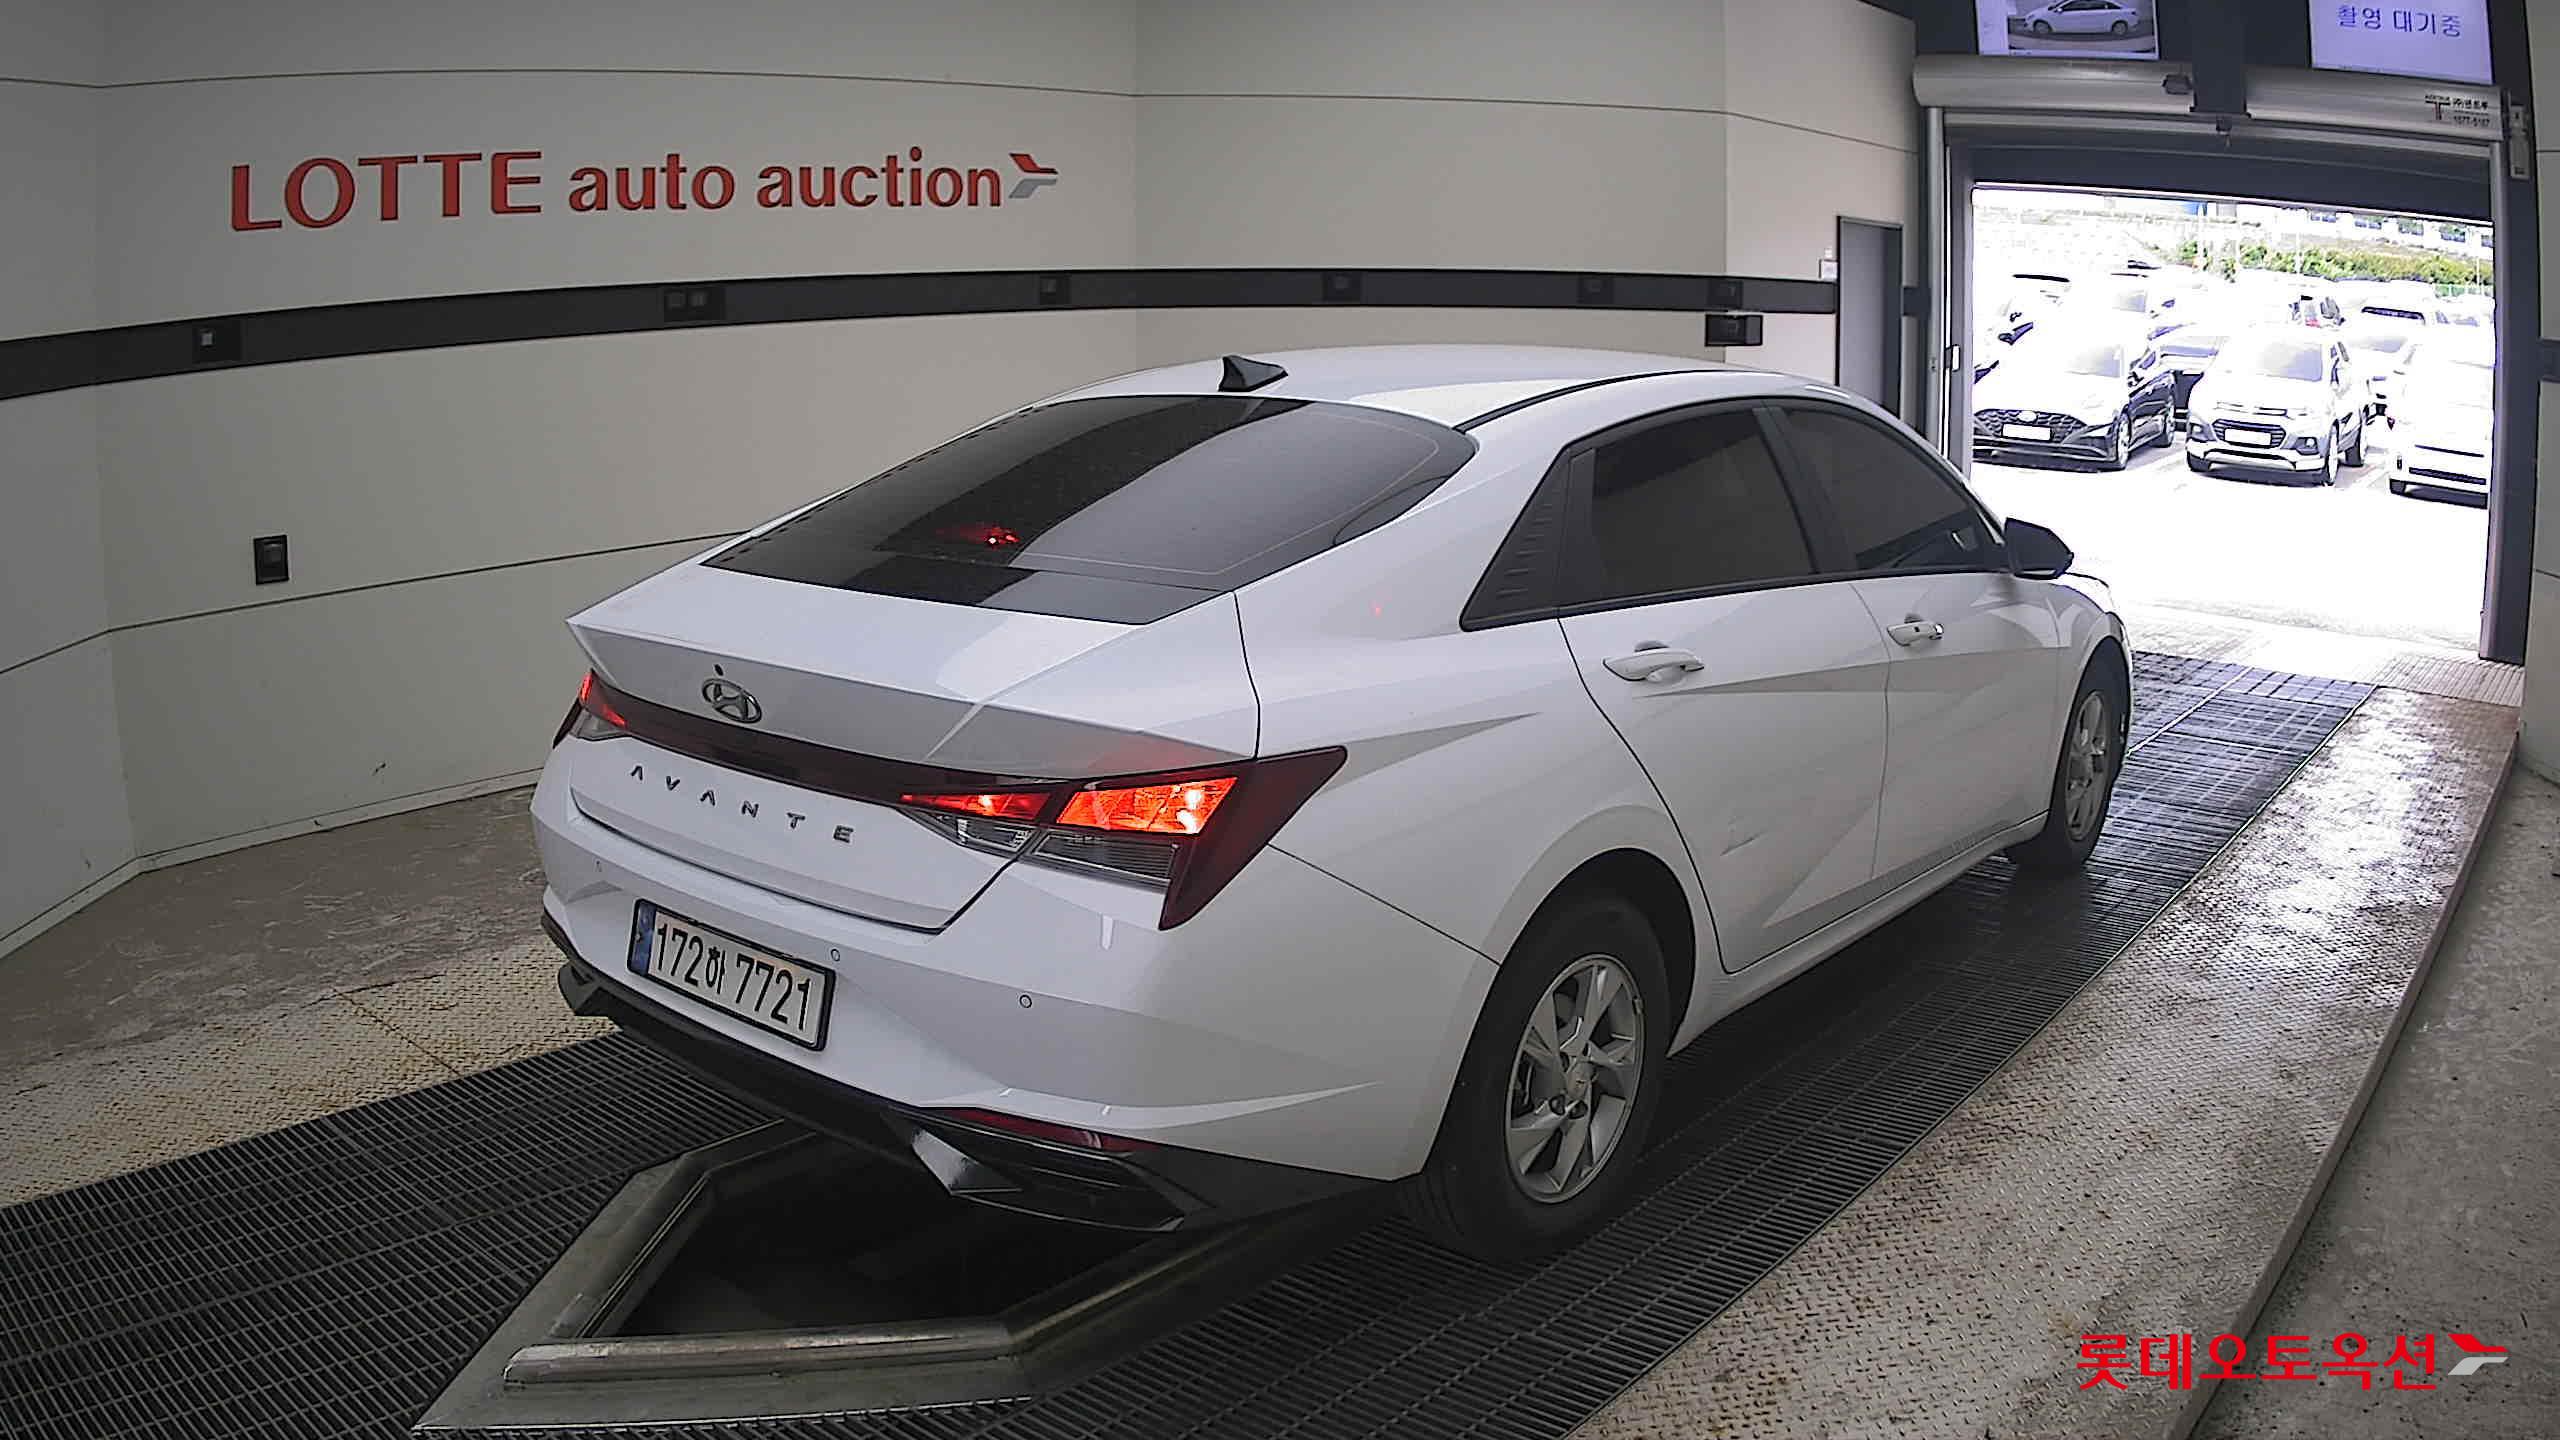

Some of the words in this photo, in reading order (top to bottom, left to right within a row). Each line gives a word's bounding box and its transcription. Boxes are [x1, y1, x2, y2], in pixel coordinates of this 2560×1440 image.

[2338, 4, 2381, 30] 촬영
[2393, 10, 2461, 38] 대기중
[231, 151, 542, 232] LOTTE
[568, 153, 735, 212] auto
[756, 145, 1002, 208] auction
[631, 765, 854, 844] AVANTE
[657, 923, 726, 995] 172하
[736, 952, 812, 1031] 7721
